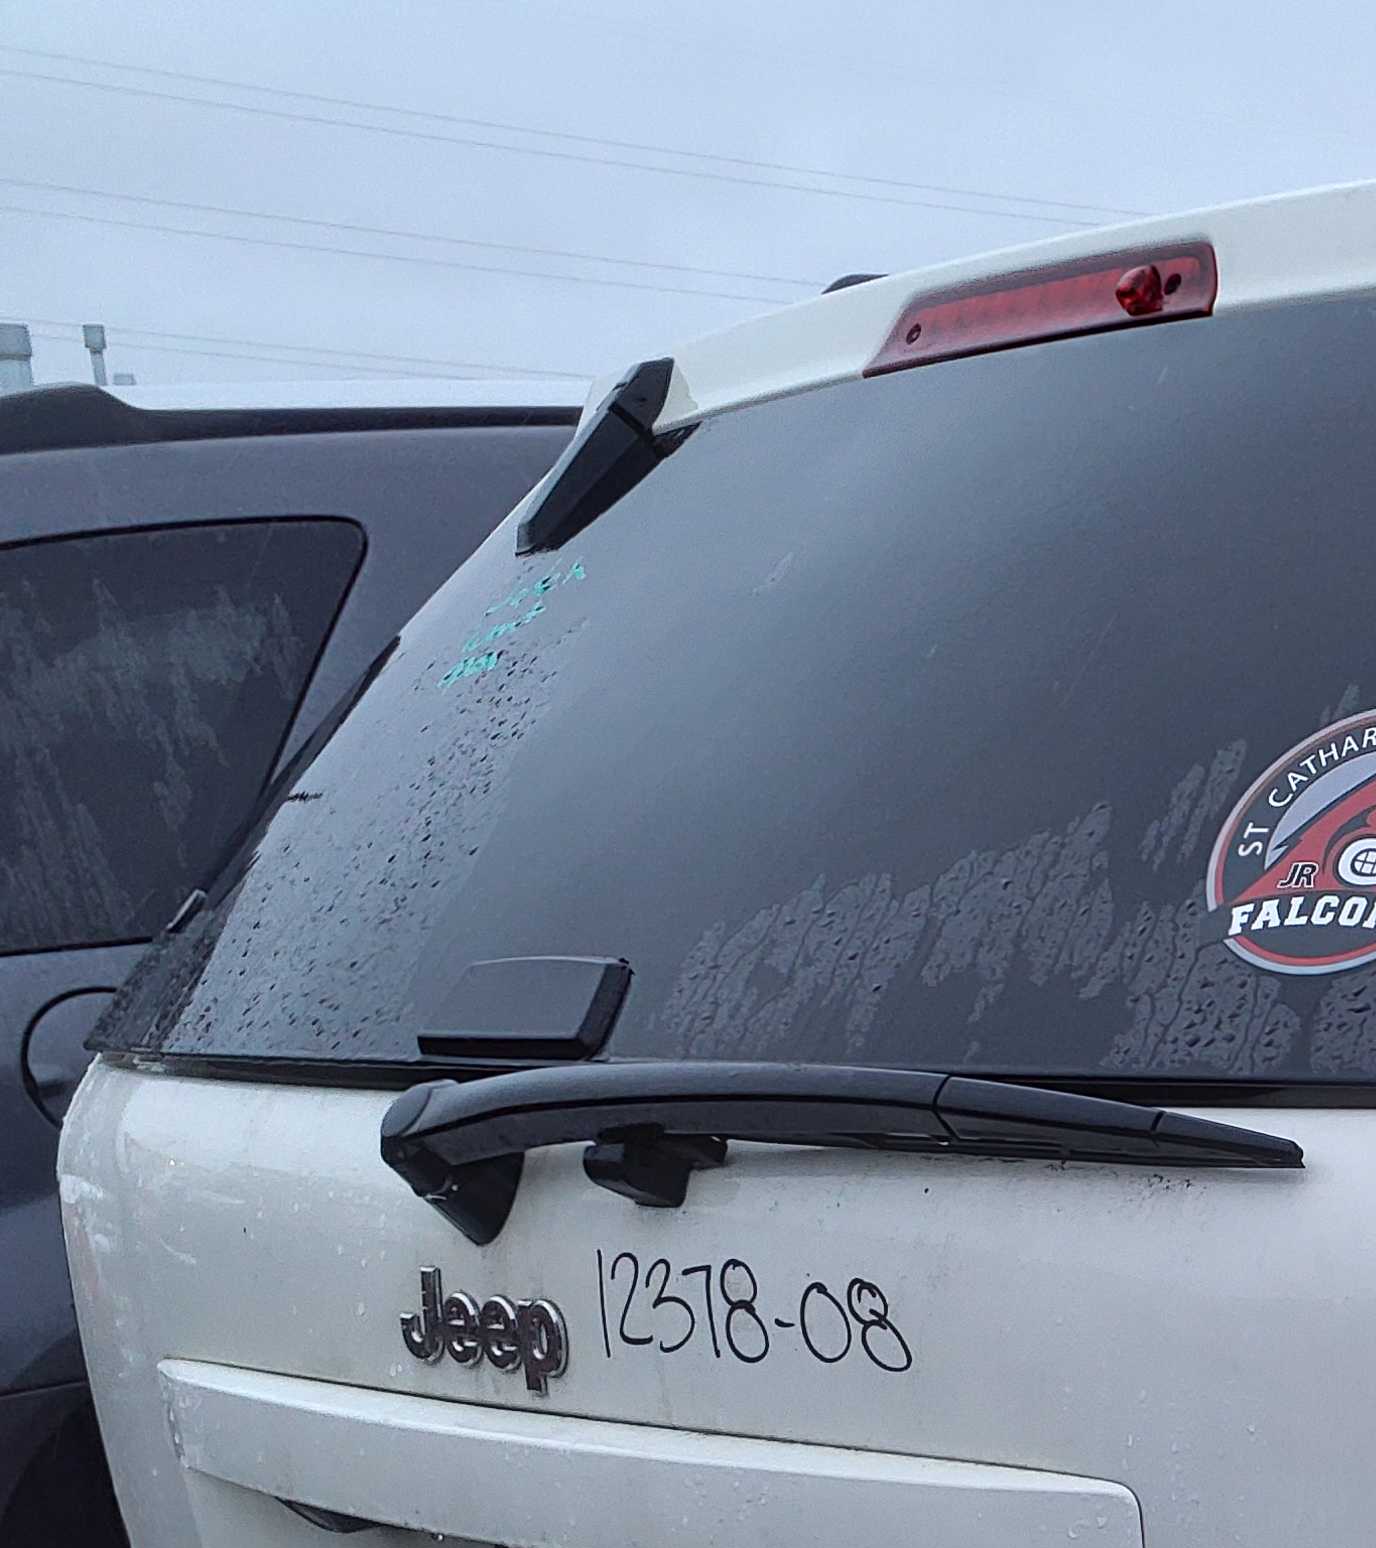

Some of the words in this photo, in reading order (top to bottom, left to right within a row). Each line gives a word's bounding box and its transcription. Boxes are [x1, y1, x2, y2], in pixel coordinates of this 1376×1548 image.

[1238, 822, 1269, 858] ST
[1277, 861, 1319, 889] JR
[400, 1264, 569, 1397] Jeep
[597, 1248, 913, 1373] 12378-08
